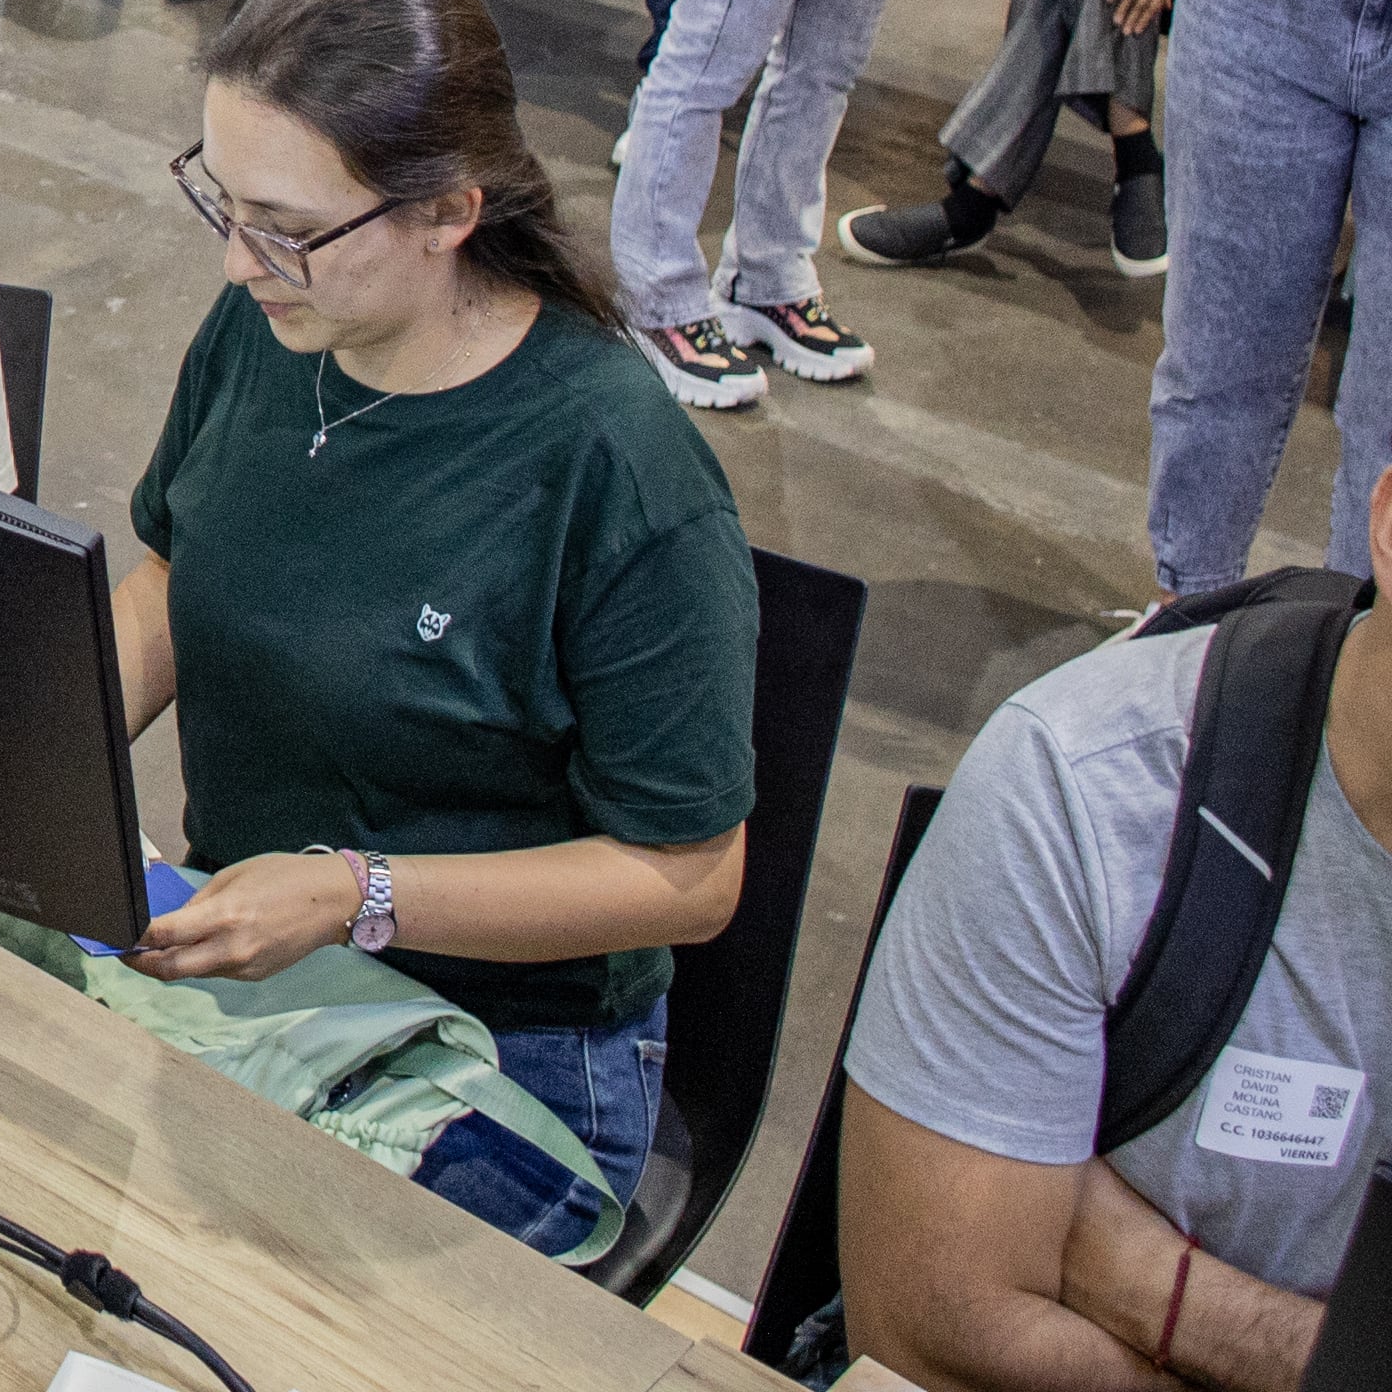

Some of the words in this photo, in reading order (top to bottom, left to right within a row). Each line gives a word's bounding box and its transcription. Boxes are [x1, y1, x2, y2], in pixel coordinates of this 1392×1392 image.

[1233, 1063, 1292, 1084] CRISTIAN
[1241, 1079, 1279, 1095] DAVID
[1232, 1091, 1281, 1108] MOLINA
[1220, 1122, 1245, 1137] C.C.
[1279, 1147, 1329, 1162] VIERNES
